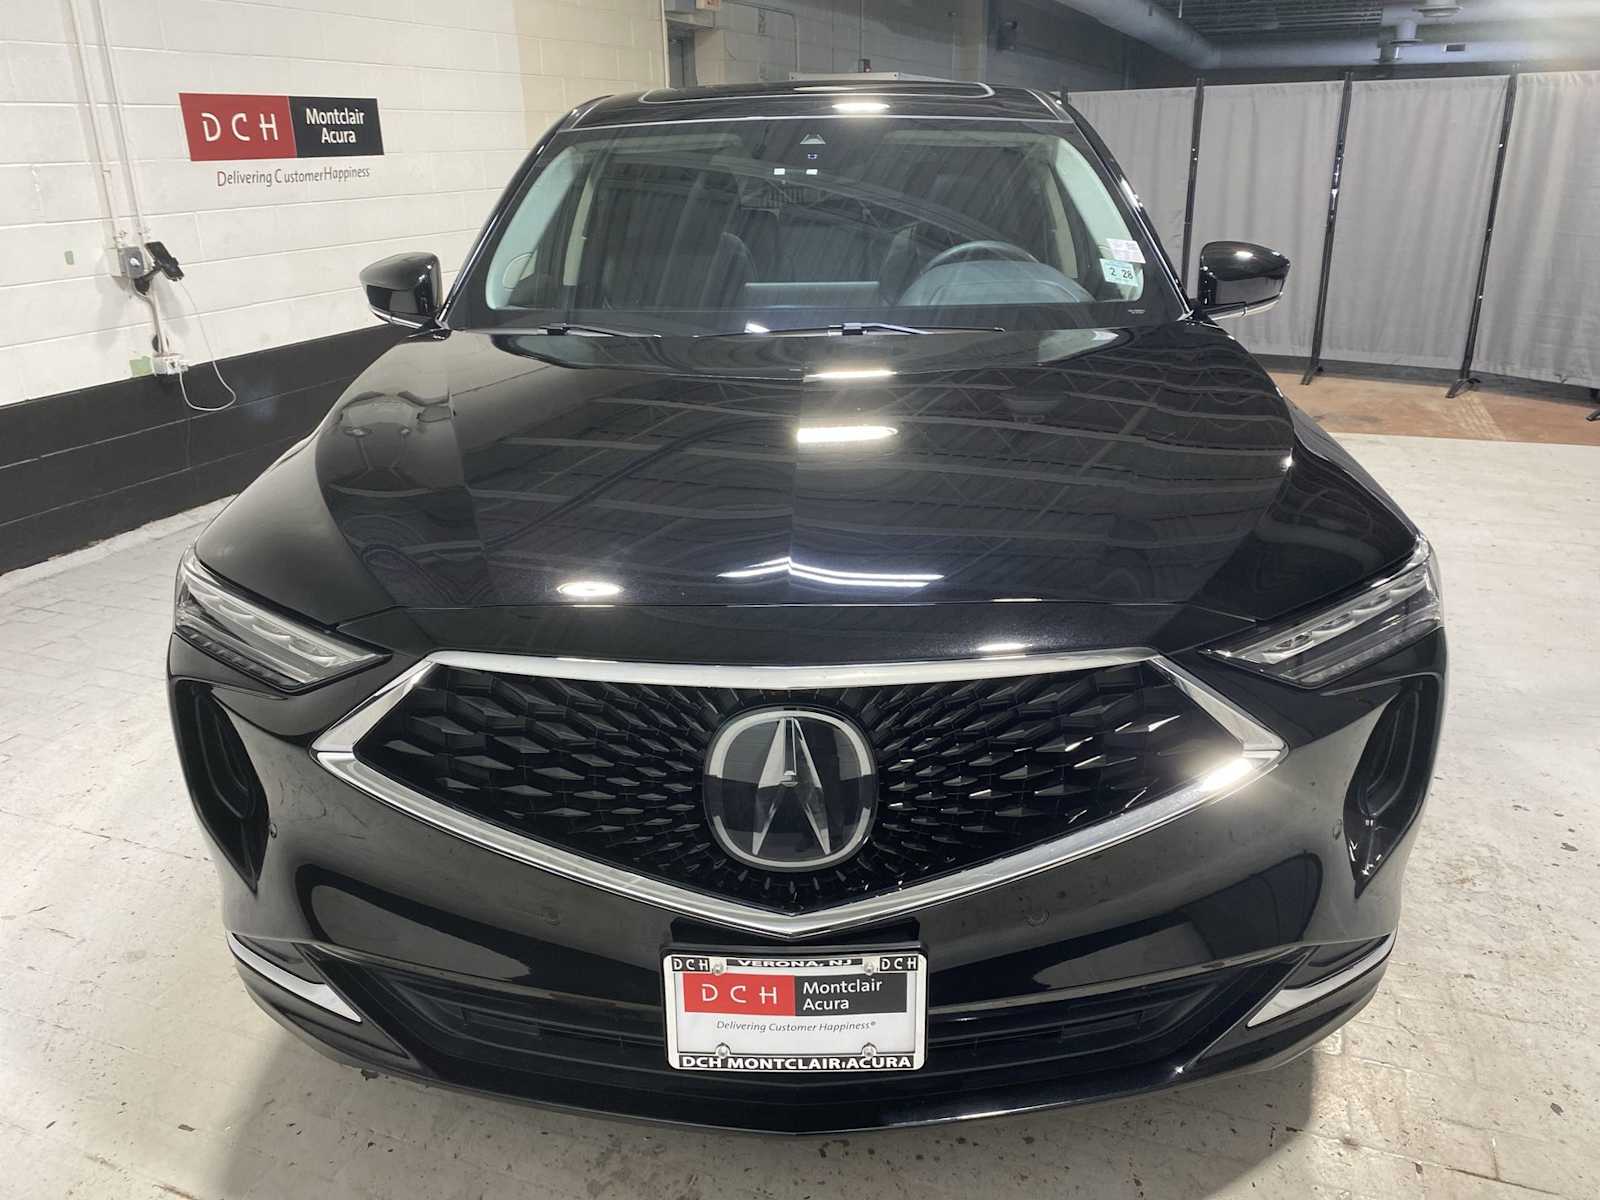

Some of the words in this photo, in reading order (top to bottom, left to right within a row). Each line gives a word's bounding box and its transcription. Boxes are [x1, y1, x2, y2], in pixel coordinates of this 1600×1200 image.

[306, 108, 365, 125] Montclair
[201, 112, 279, 142] DCH
[321, 128, 356, 144] Acura
[217, 170, 272, 187] Delivering
[274, 168, 324, 184] Customer
[324, 166, 370, 182] Happiness
[673, 958, 709, 970] DCH
[737, 959, 824, 967] VERONA,
[829, 959, 852, 967] NJ
[881, 957, 917, 970] DCH
[701, 983, 778, 1005] DCH
[803, 978, 882, 995] Montclair
[803, 998, 850, 1011] Acura
[716, 1020, 767, 1033] Delivering
[768, 1022, 816, 1032] Customer
[682, 1056, 721, 1068] DCH
[727, 1057, 841, 1070] MONTCLAIR
[846, 1056, 912, 1069] ACURA
